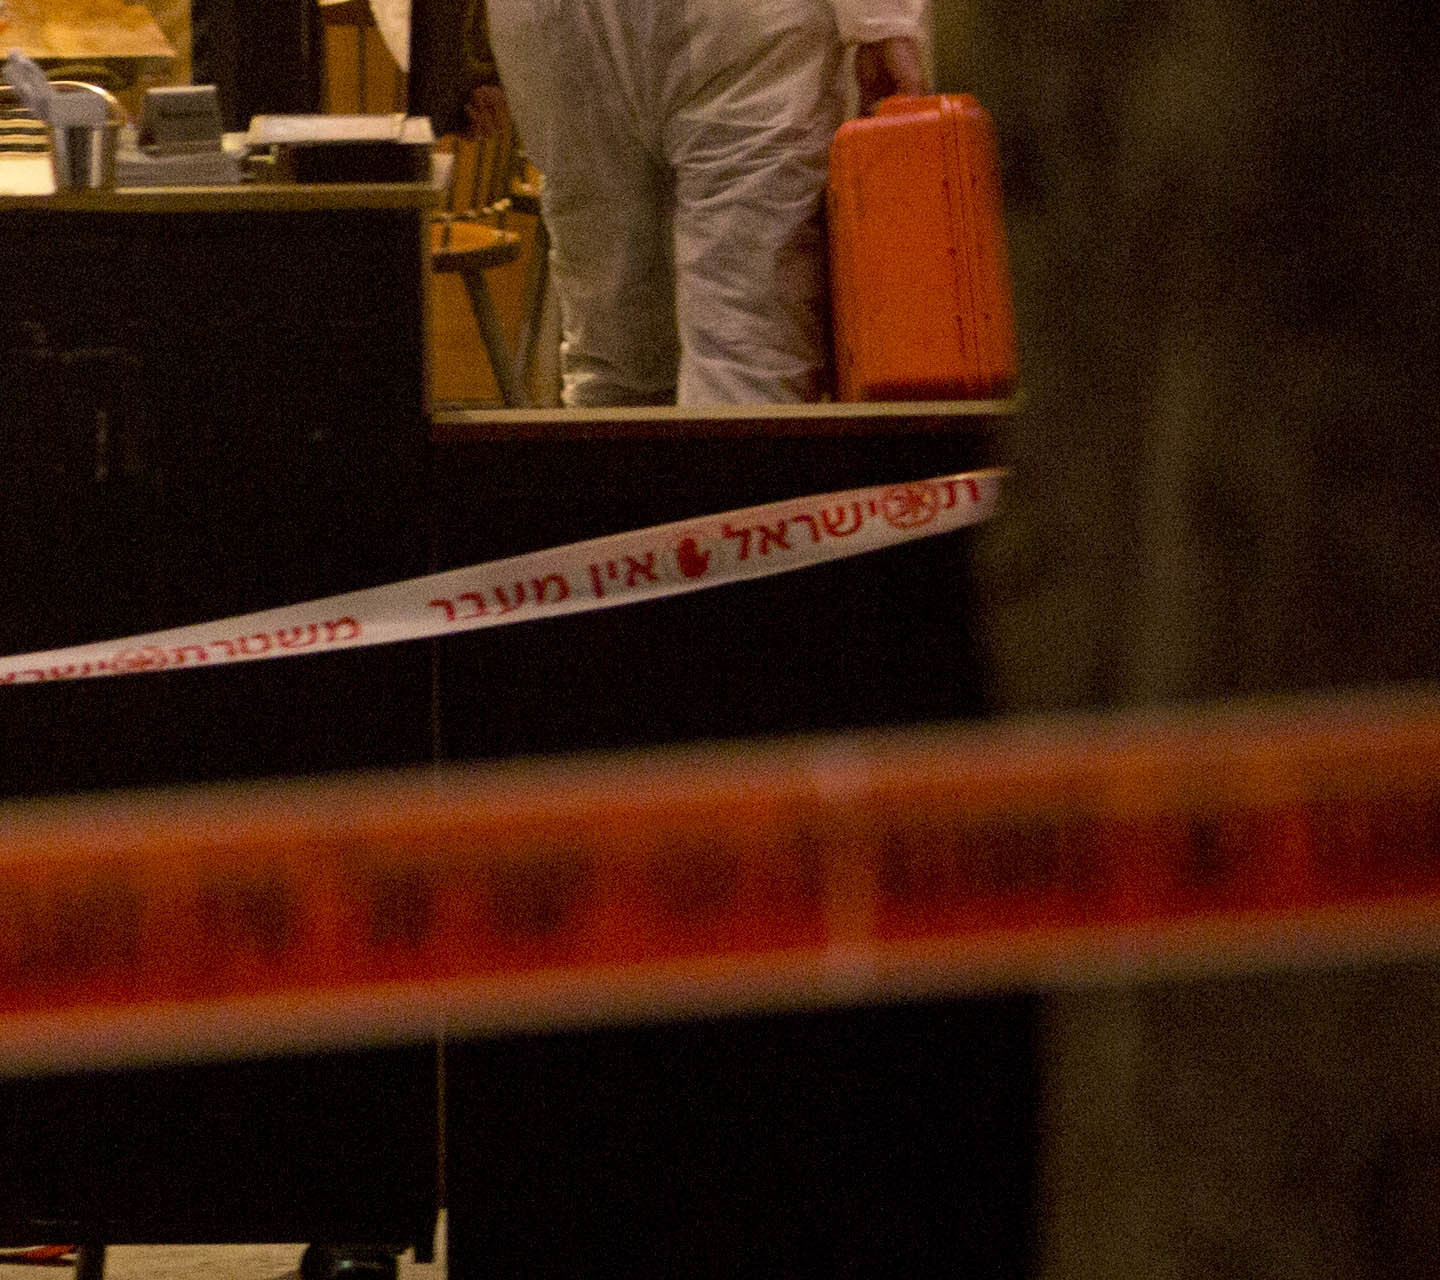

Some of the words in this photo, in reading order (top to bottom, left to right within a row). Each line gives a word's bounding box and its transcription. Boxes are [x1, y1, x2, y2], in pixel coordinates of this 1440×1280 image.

[721, 498, 878, 562] ישראל
[428, 571, 571, 622] מעבר
[587, 550, 659, 599] אין
[175, 615, 363, 666] משטרת
